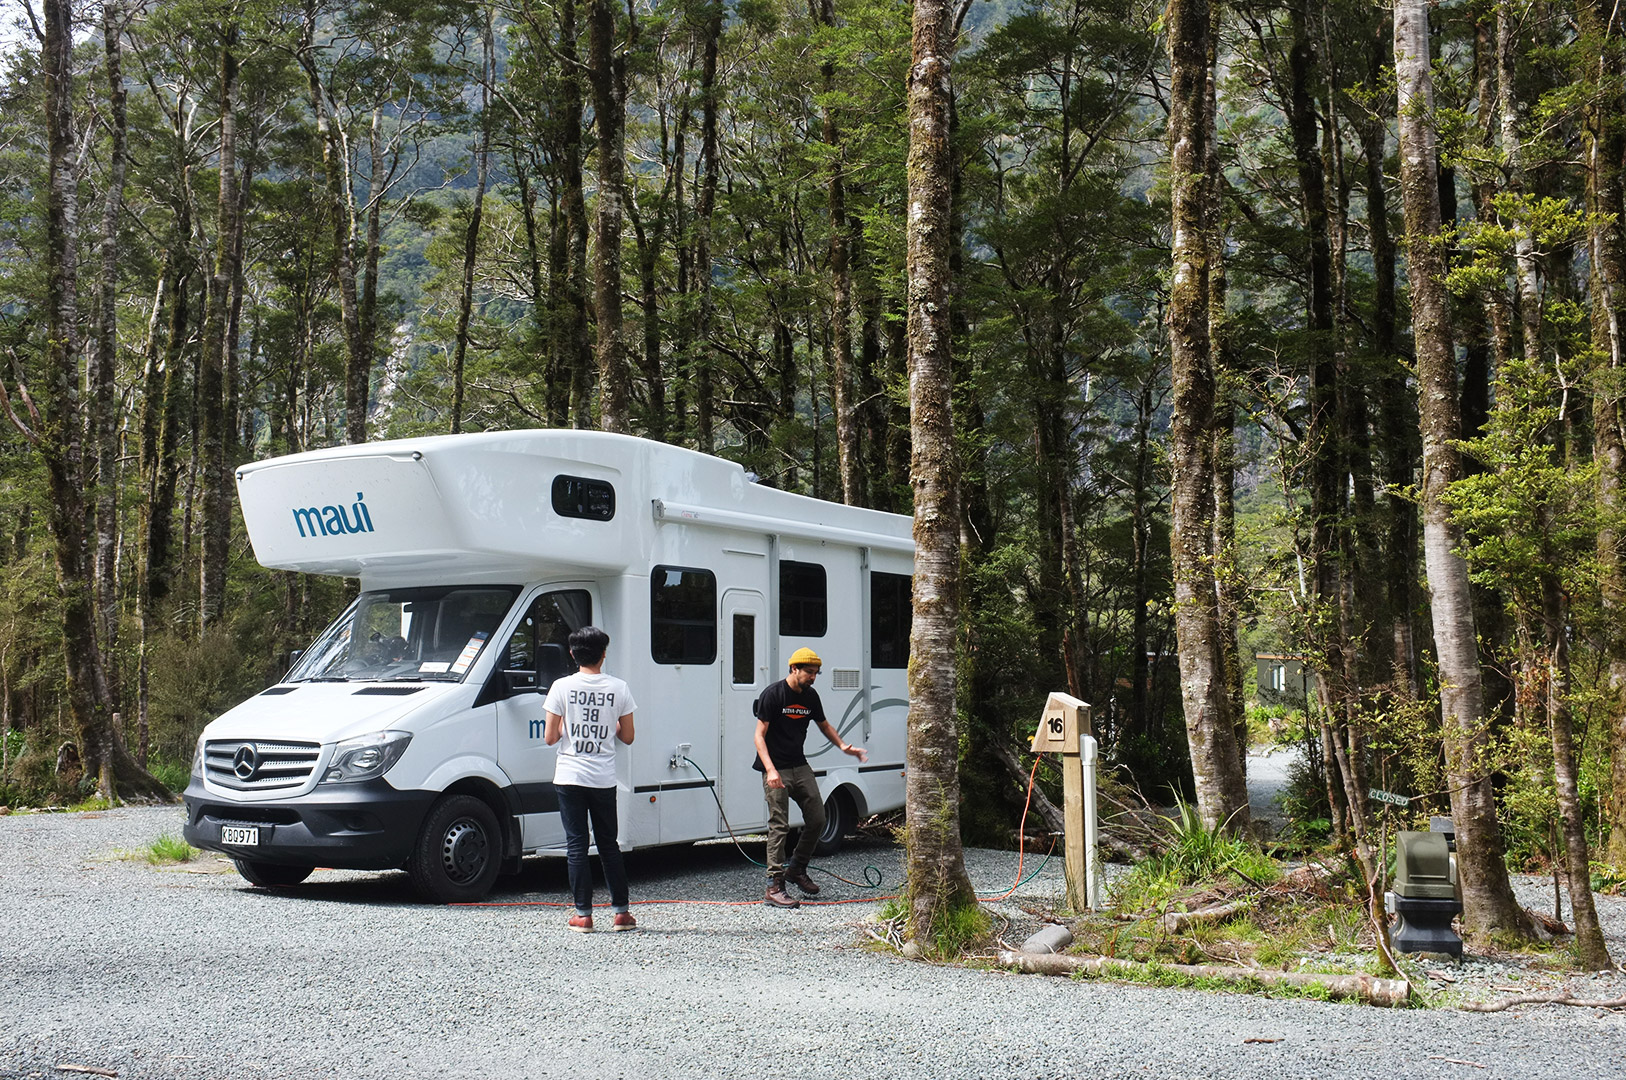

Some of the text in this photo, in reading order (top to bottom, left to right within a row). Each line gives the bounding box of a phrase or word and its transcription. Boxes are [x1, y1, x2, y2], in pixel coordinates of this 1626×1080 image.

[1047, 717, 1063, 734] 16
[1369, 789, 1409, 806] CLOSED
[222, 828, 257, 844] KBQ971
